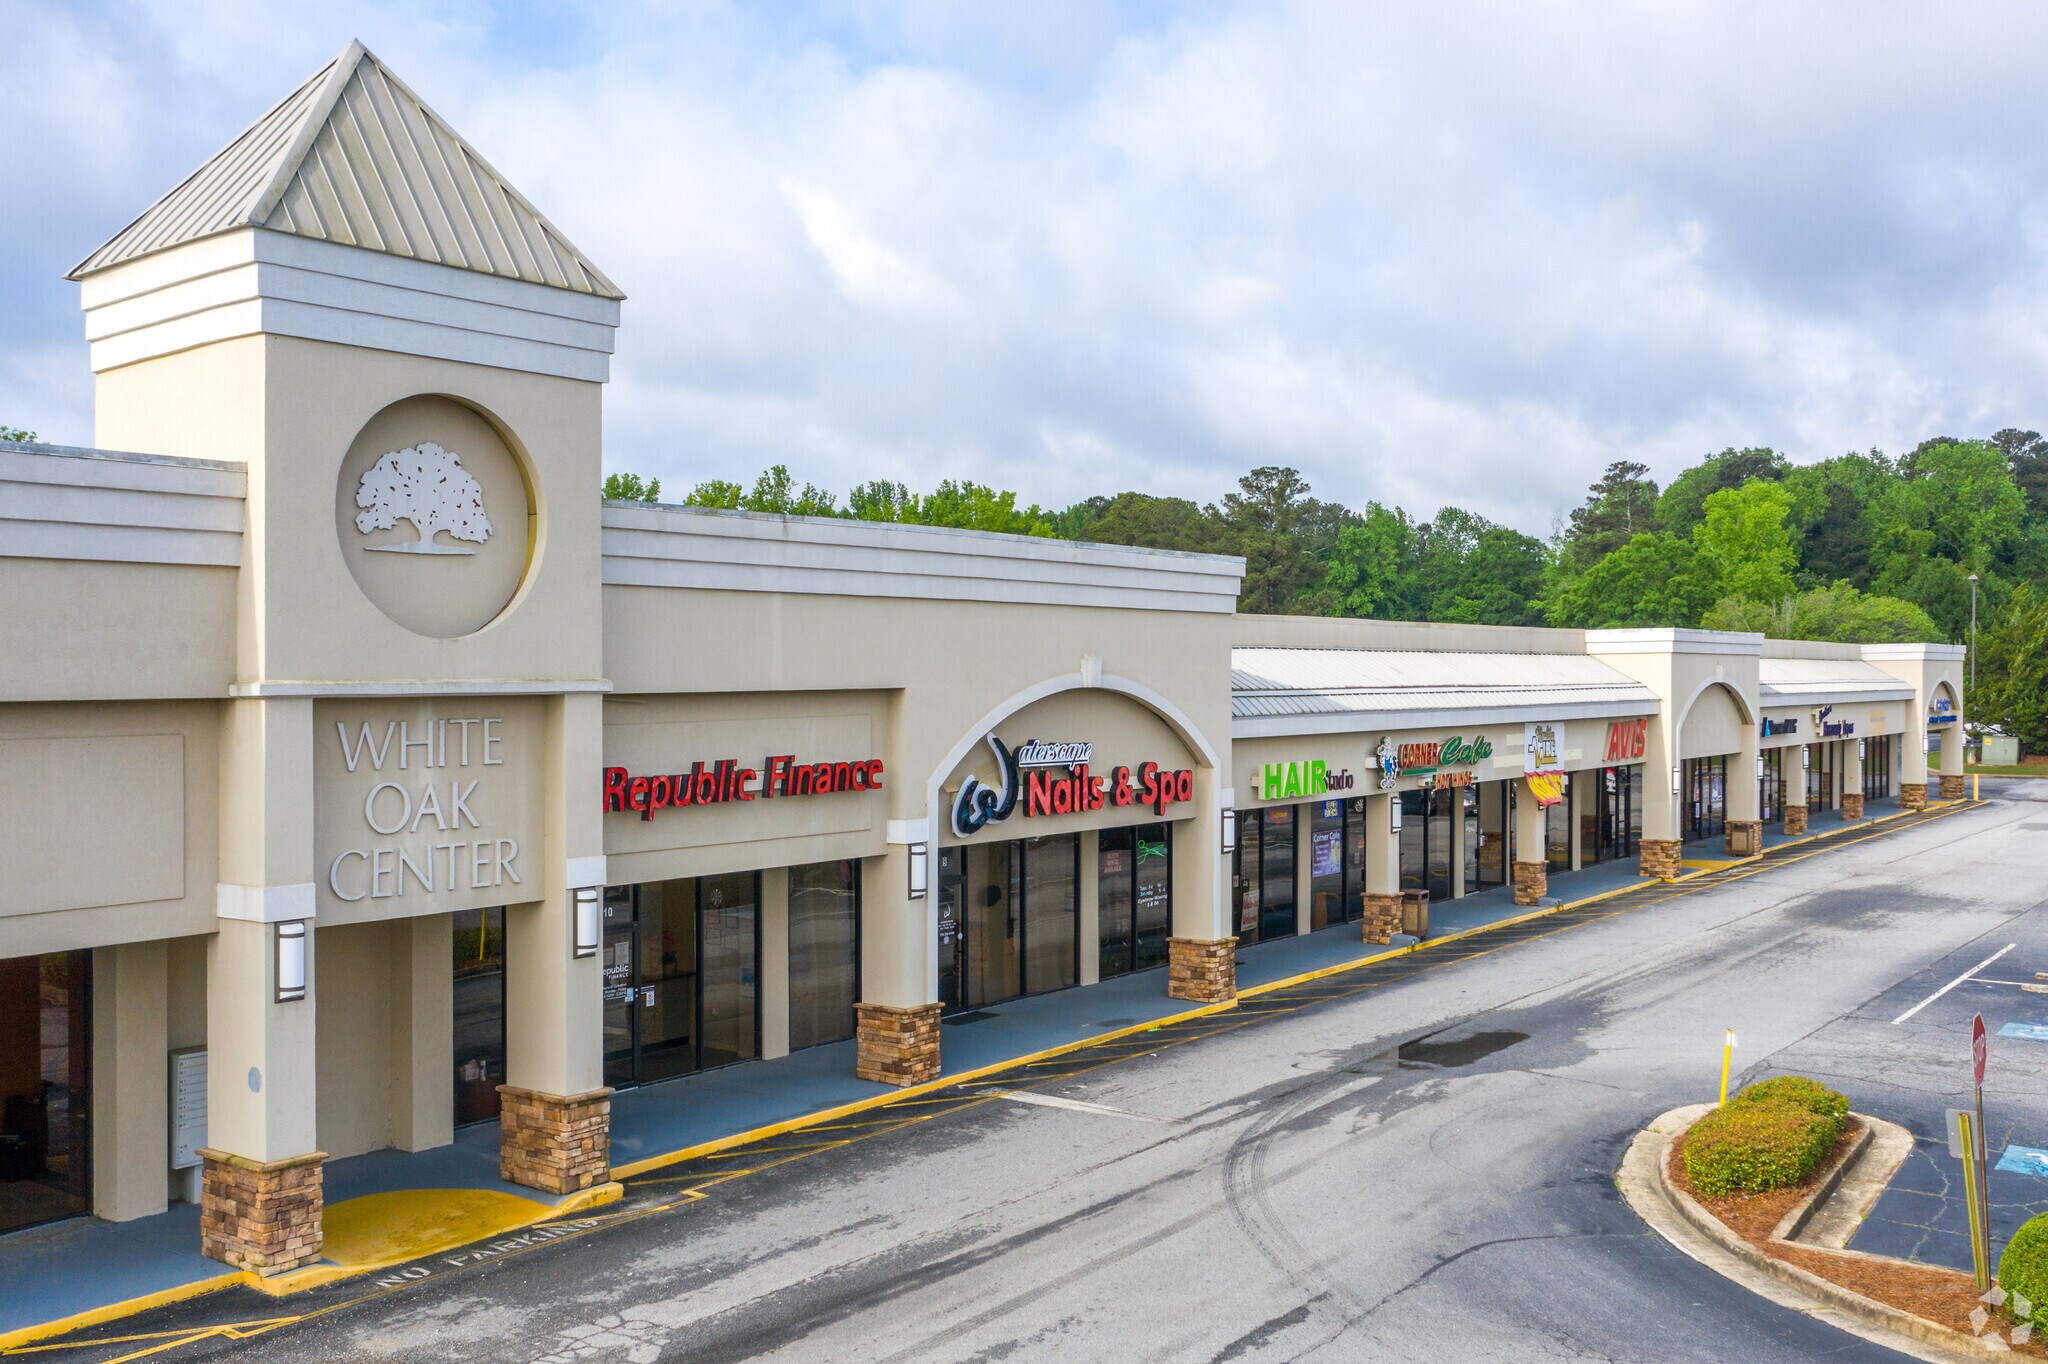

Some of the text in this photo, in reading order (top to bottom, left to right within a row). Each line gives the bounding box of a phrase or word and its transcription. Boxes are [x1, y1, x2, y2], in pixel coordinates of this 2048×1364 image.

[336, 718, 503, 772] WHITE
[1400, 735, 1493, 768] CORNER Cafe
[1606, 720, 1647, 760] AVIS
[602, 755, 884, 822] Republic Finance
[1024, 761, 1193, 817] Nails & Spa
[1264, 759, 1328, 800] HAIR
[365, 780, 480, 835] OAK
[1313, 834, 1330, 843] Corner
[330, 837, 521, 902] CENTER
[603, 907, 613, 917] 10
[602, 964, 629, 977] epublic
[1973, 1033, 1985, 1068] STOP
[372, 1219, 598, 1289] NO PARKING
